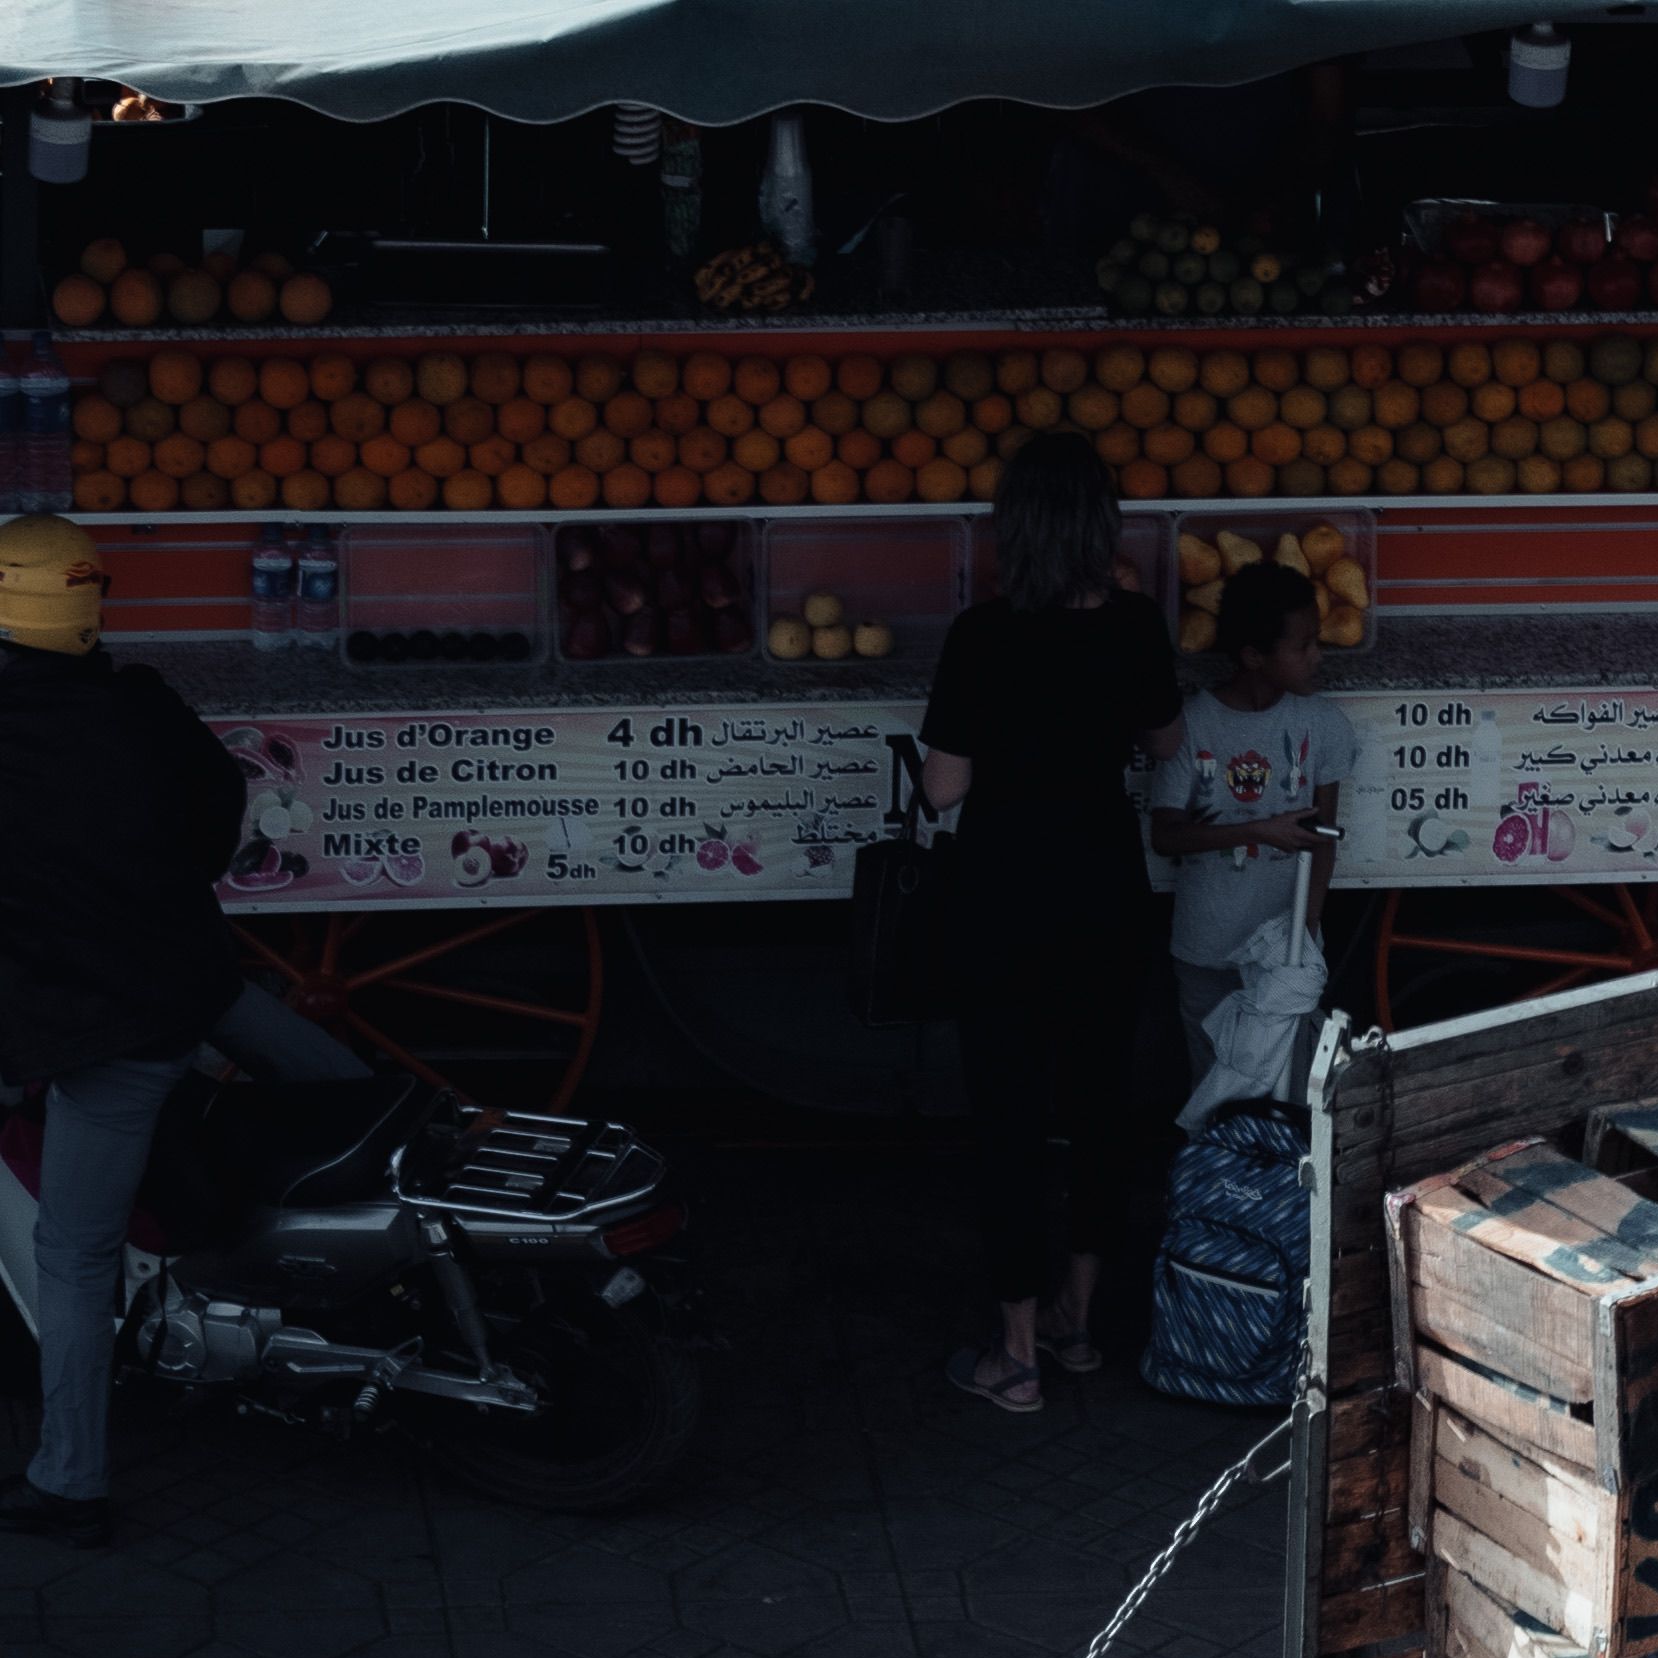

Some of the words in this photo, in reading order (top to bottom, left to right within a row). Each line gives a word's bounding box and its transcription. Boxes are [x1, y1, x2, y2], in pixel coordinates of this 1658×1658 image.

[1395, 703, 1429, 726] 10
[1437, 703, 1472, 726] dh
[1533, 700, 1624, 730] الفواكه
[323, 726, 385, 749] Jus
[607, 717, 635, 747] 4
[650, 717, 703, 747] dh
[711, 718, 805, 747] البرتقال
[808, 722, 880, 745] عصير
[706, 755, 806, 784] الحامض
[1393, 746, 1428, 769] 10
[1436, 745, 1471, 768] dh
[1513, 744, 1577, 772] كبير
[1580, 745, 1651, 774] معدني
[323, 761, 385, 785] Jus
[397, 760, 439, 783] de
[451, 758, 558, 783] Citron
[613, 759, 650, 781] 10
[659, 759, 697, 780] dh
[808, 759, 879, 781] عصير
[323, 797, 366, 822] Jus
[374, 797, 404, 820] de
[413, 794, 600, 823] Pamplemousse
[613, 797, 649, 818] 10
[659, 796, 697, 818] dh
[720, 790, 815, 819] البليموس
[814, 793, 878, 817] عصير
[1391, 788, 1425, 811] 05
[1434, 787, 1469, 811] dh
[1511, 784, 1575, 812] صغير
[1578, 785, 1650, 814] معدني
[323, 832, 422, 857] Mixte
[613, 834, 649, 856] 10
[659, 834, 697, 855] dh
[791, 824, 878, 846] مختلط
